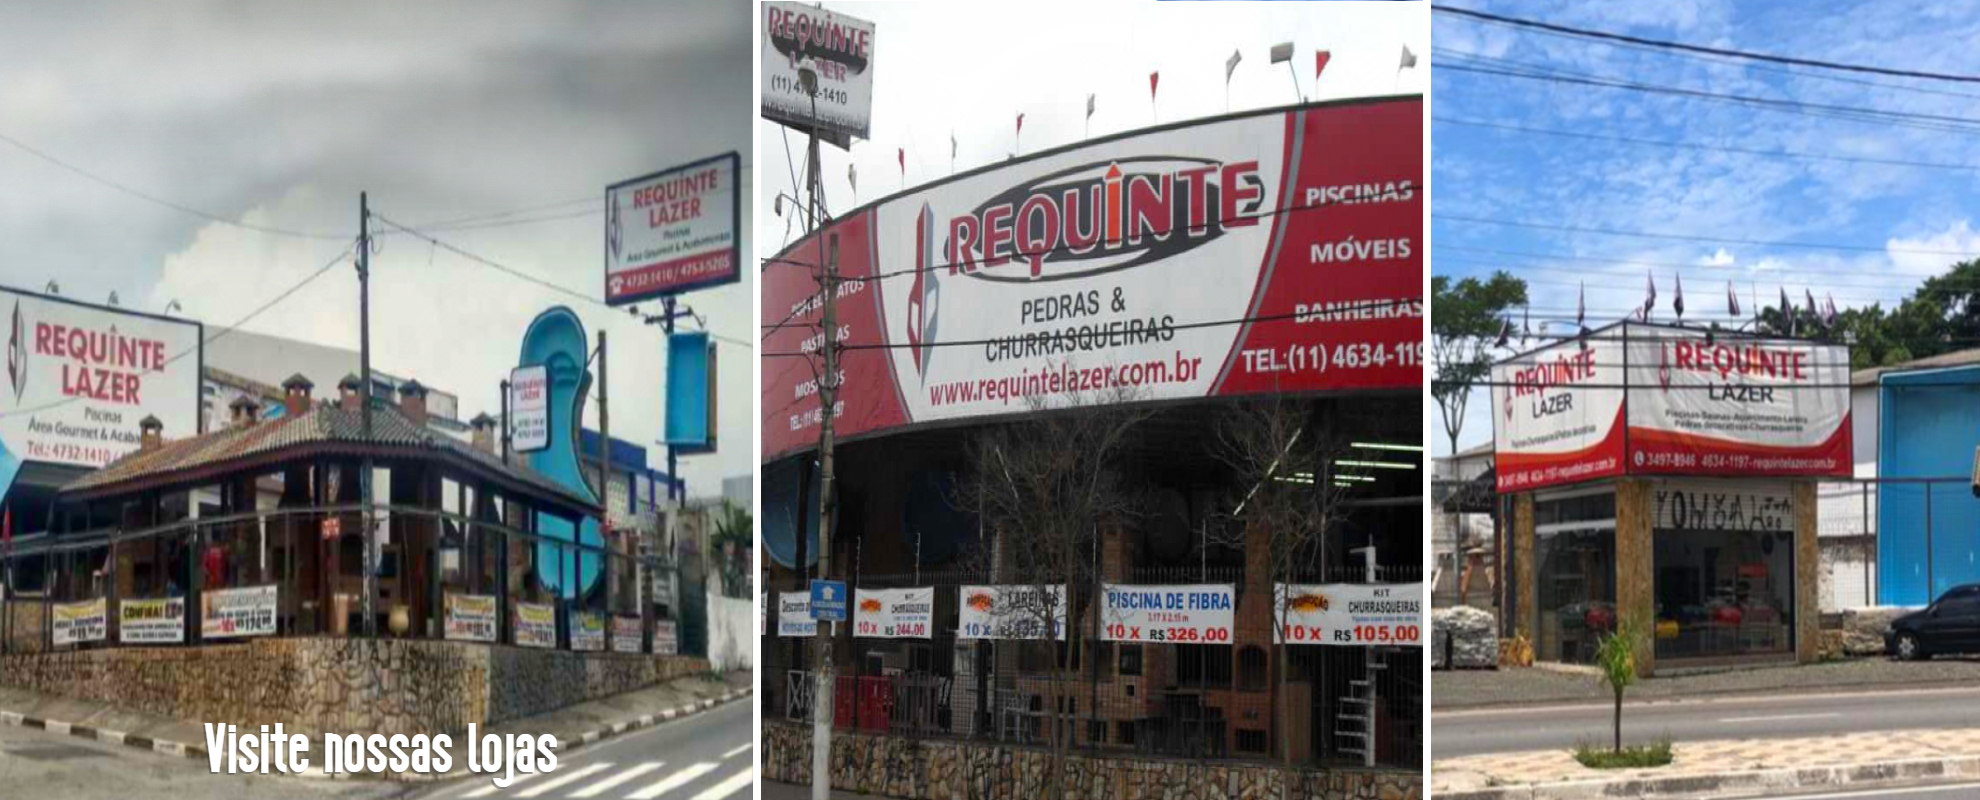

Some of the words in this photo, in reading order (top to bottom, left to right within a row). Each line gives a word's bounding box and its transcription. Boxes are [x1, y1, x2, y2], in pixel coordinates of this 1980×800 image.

[768, 6, 870, 59] REQUINTE
[789, 51, 848, 83] LZER
[771, 74, 792, 94] (11)
[634, 168, 718, 209] REQUINTE
[1306, 180, 1414, 207] PISCINAS
[650, 197, 702, 229] LAZER
[948, 159, 1260, 280] REQUINTE
[1309, 234, 1412, 264] MÓVEIS
[1021, 291, 1100, 325] PEDRAS
[1110, 286, 1126, 312] &
[1294, 297, 1423, 324] BANHEIRAS
[35, 320, 165, 372] REQUINTE
[985, 315, 1175, 363] CHURRASQUEIRAS
[1515, 348, 1596, 398] REQUINTE
[1675, 339, 1808, 380] REQUINTE
[62, 365, 141, 406] LAZER
[930, 350, 1203, 407] www.requintelazer.com.br
[1532, 393, 1574, 419] LAZER
[1708, 382, 1774, 403] LAZER
[84, 406, 123, 424] Piscinas
[55, 421, 98, 440] Gourmet
[100, 428, 108, 441] &
[52, 443, 111, 462] 4732-1410
[1108, 592, 1163, 609] PISCINA
[1166, 593, 1184, 609] DE
[1188, 592, 1231, 610] FIBRA
[1373, 588, 1390, 598] KIT
[1349, 600, 1421, 614] CHURRASQUEIRAS
[858, 621, 869, 634] 10
[966, 621, 979, 636] 10
[1106, 623, 1126, 639] 10
[1150, 629, 1165, 641] R$
[1166, 626, 1229, 643] 326,00
[1286, 624, 1305, 640] 10
[1353, 624, 1420, 645] 105,00
